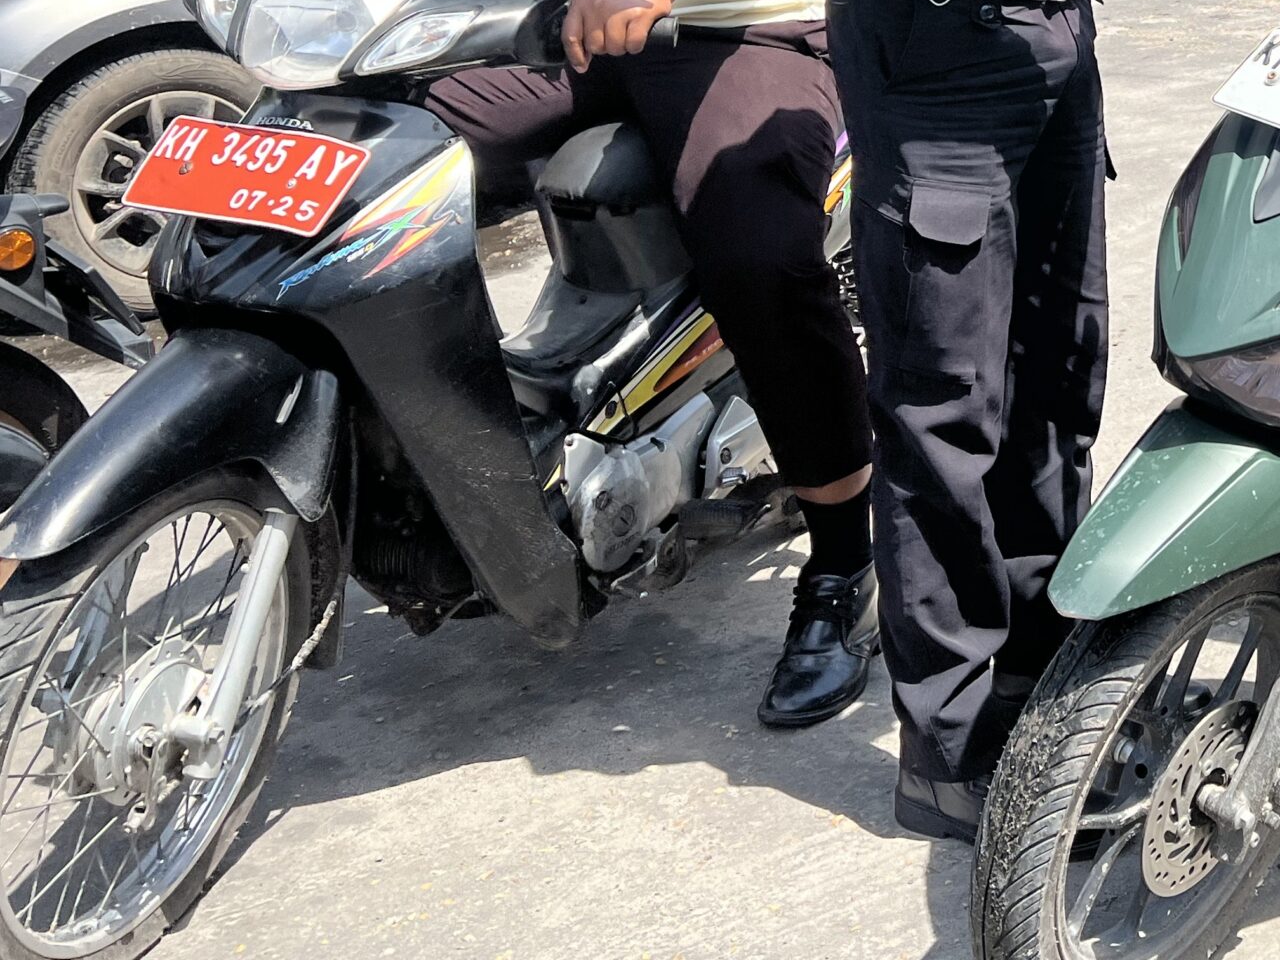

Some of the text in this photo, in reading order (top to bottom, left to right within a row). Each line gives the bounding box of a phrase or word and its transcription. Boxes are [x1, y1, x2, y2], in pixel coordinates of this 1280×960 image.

[256, 116, 314, 131] HONDA
[155, 124, 358, 187] KH 3495 AY
